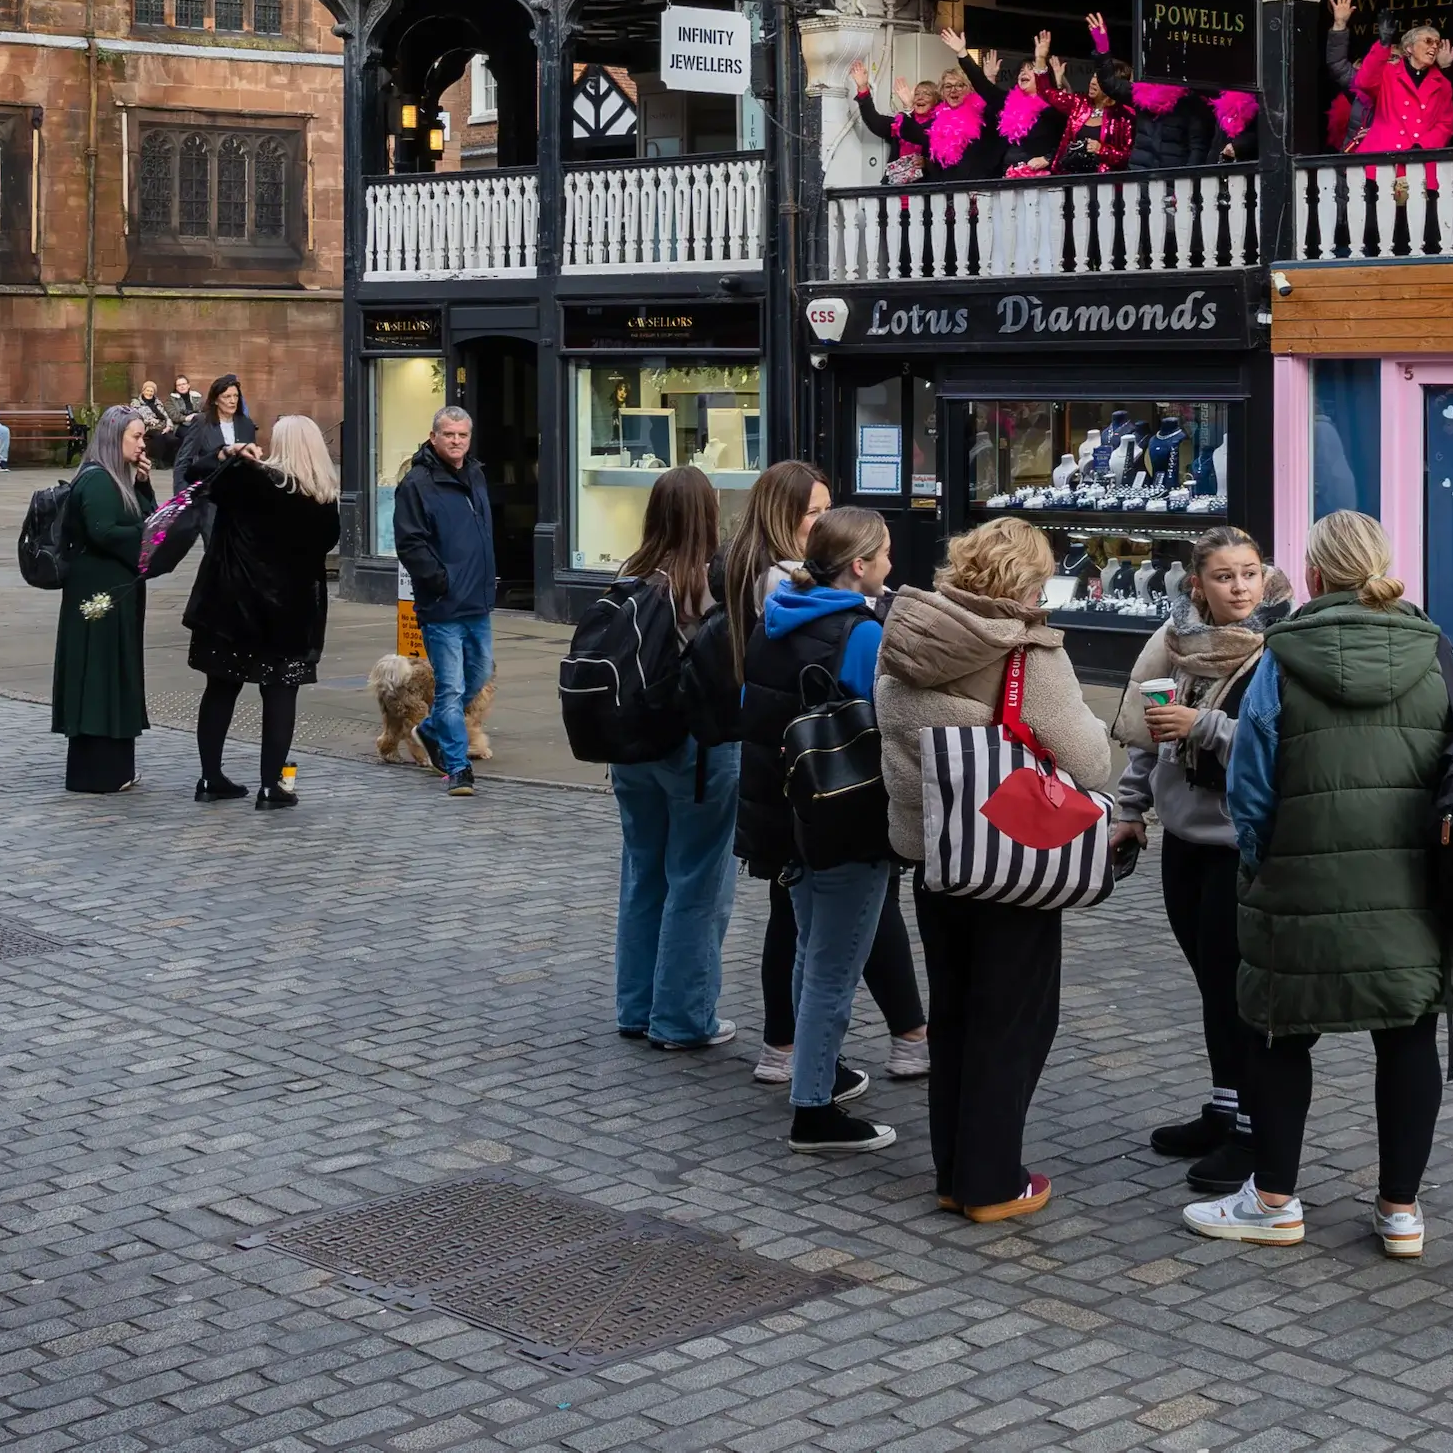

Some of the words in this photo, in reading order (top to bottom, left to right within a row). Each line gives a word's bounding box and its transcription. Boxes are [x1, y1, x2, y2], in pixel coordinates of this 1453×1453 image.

[1155, 3, 1245, 33] POWELLS
[678, 26, 734, 46] INFINITY
[1166, 30, 1234, 47] JEWELLERY
[669, 53, 742, 75] JEWELLERS
[810, 311, 835, 323] CSS
[866, 299, 969, 335] Lotus
[996, 290, 1218, 334] Diamonds
[1404, 365, 1414, 381] 5
[1008, 681, 1018, 707] LULU
